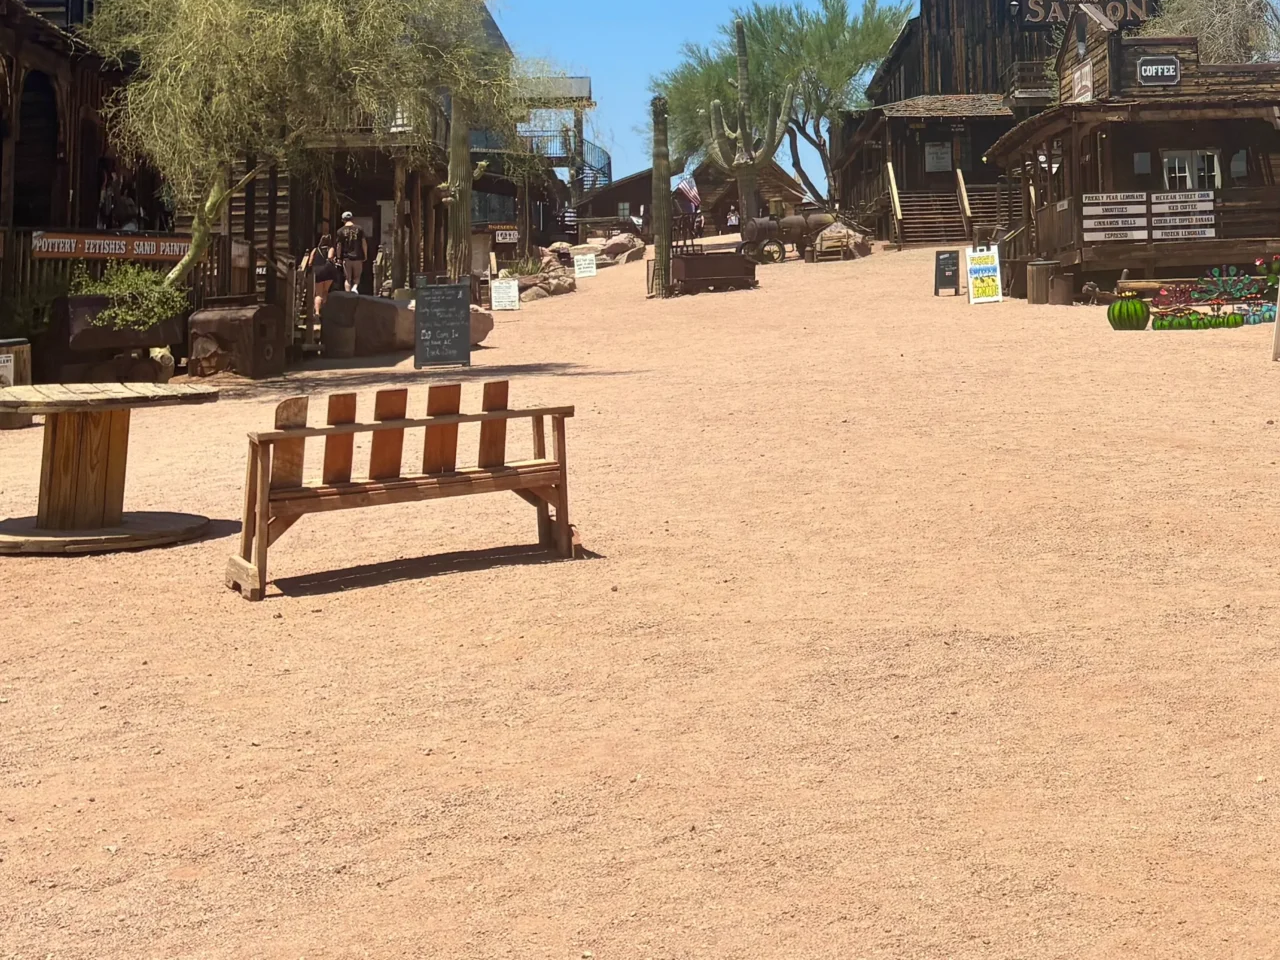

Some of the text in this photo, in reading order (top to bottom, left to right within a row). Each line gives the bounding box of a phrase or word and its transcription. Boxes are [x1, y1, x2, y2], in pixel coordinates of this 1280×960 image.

[1142, 65, 1176, 76] COFFEE
[35, 239, 76, 252] POTTERY
[84, 239, 126, 253] FETISHES
[133, 241, 156, 255] SAND
